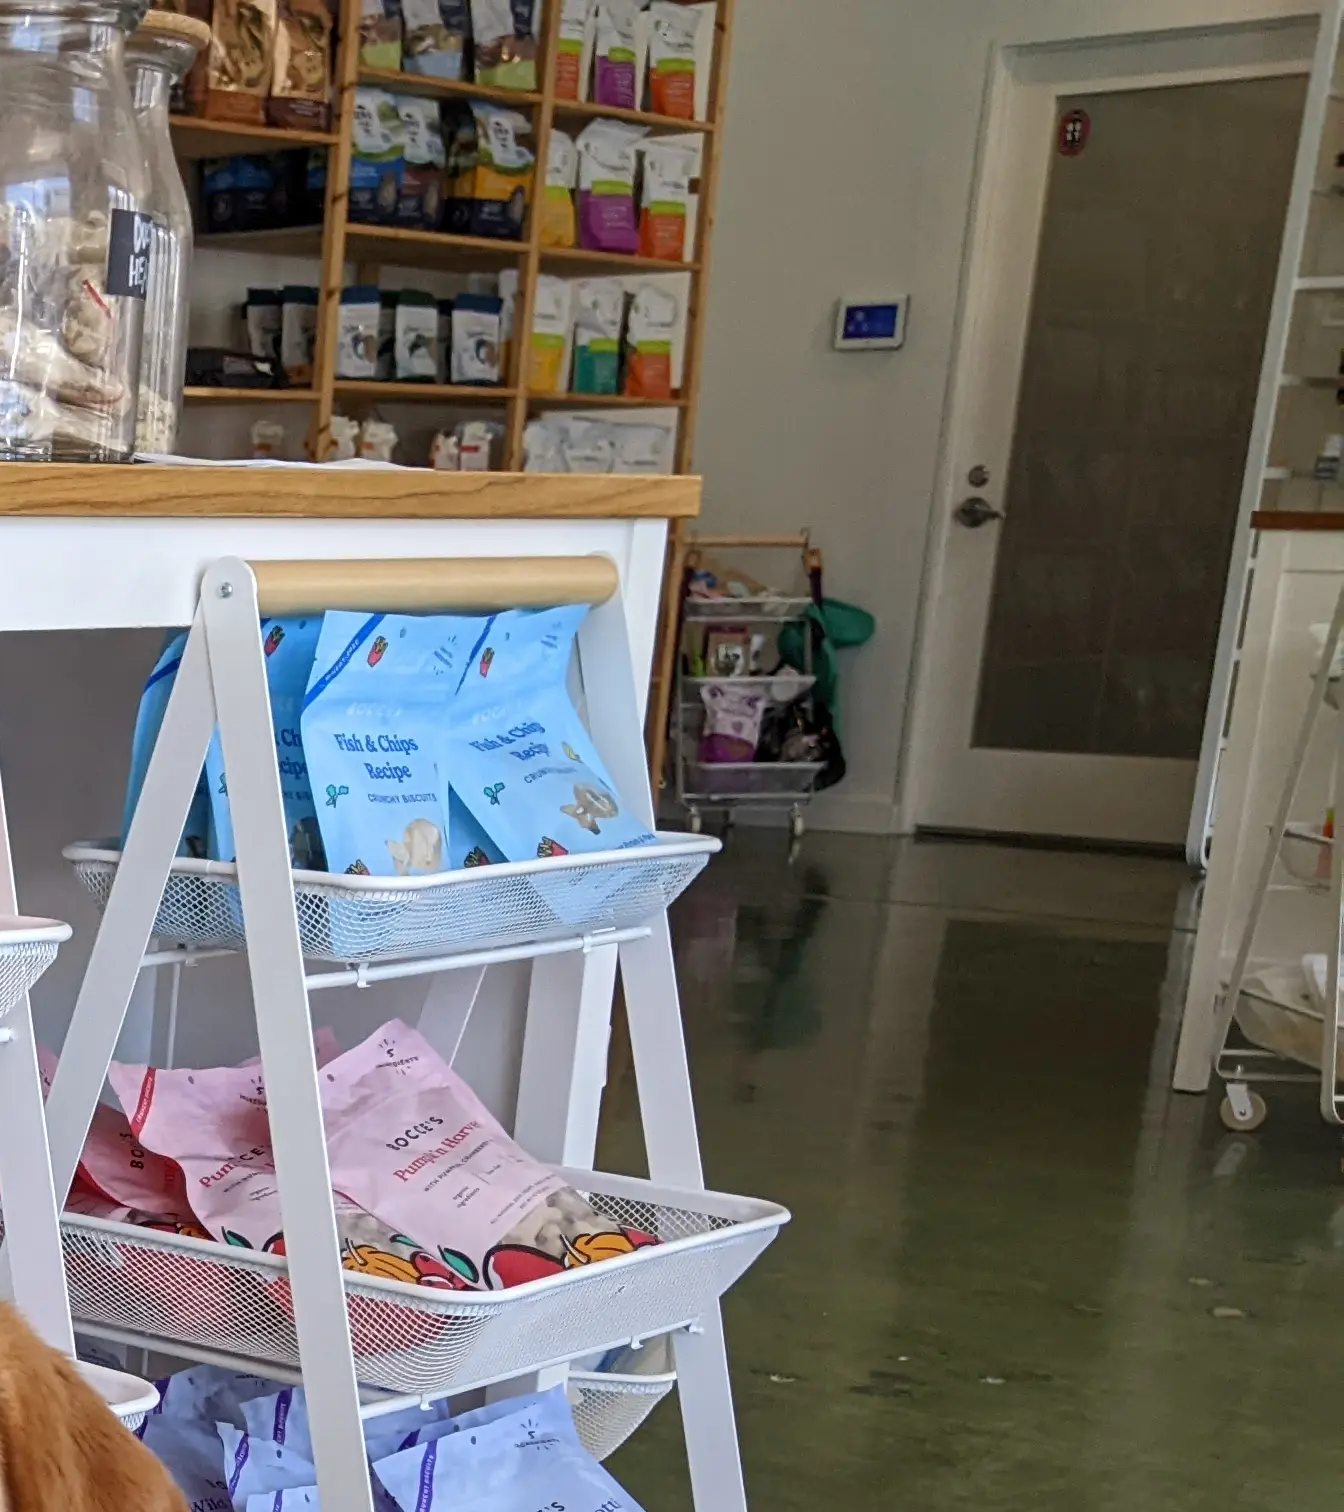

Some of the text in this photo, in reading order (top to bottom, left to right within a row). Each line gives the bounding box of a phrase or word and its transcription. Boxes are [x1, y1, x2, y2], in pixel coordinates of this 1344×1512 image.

[334, 733, 419, 755] Fish & Chips
[364, 762, 413, 783] Recipe
[368, 793, 437, 803] CRUNCHY BISCUITS
